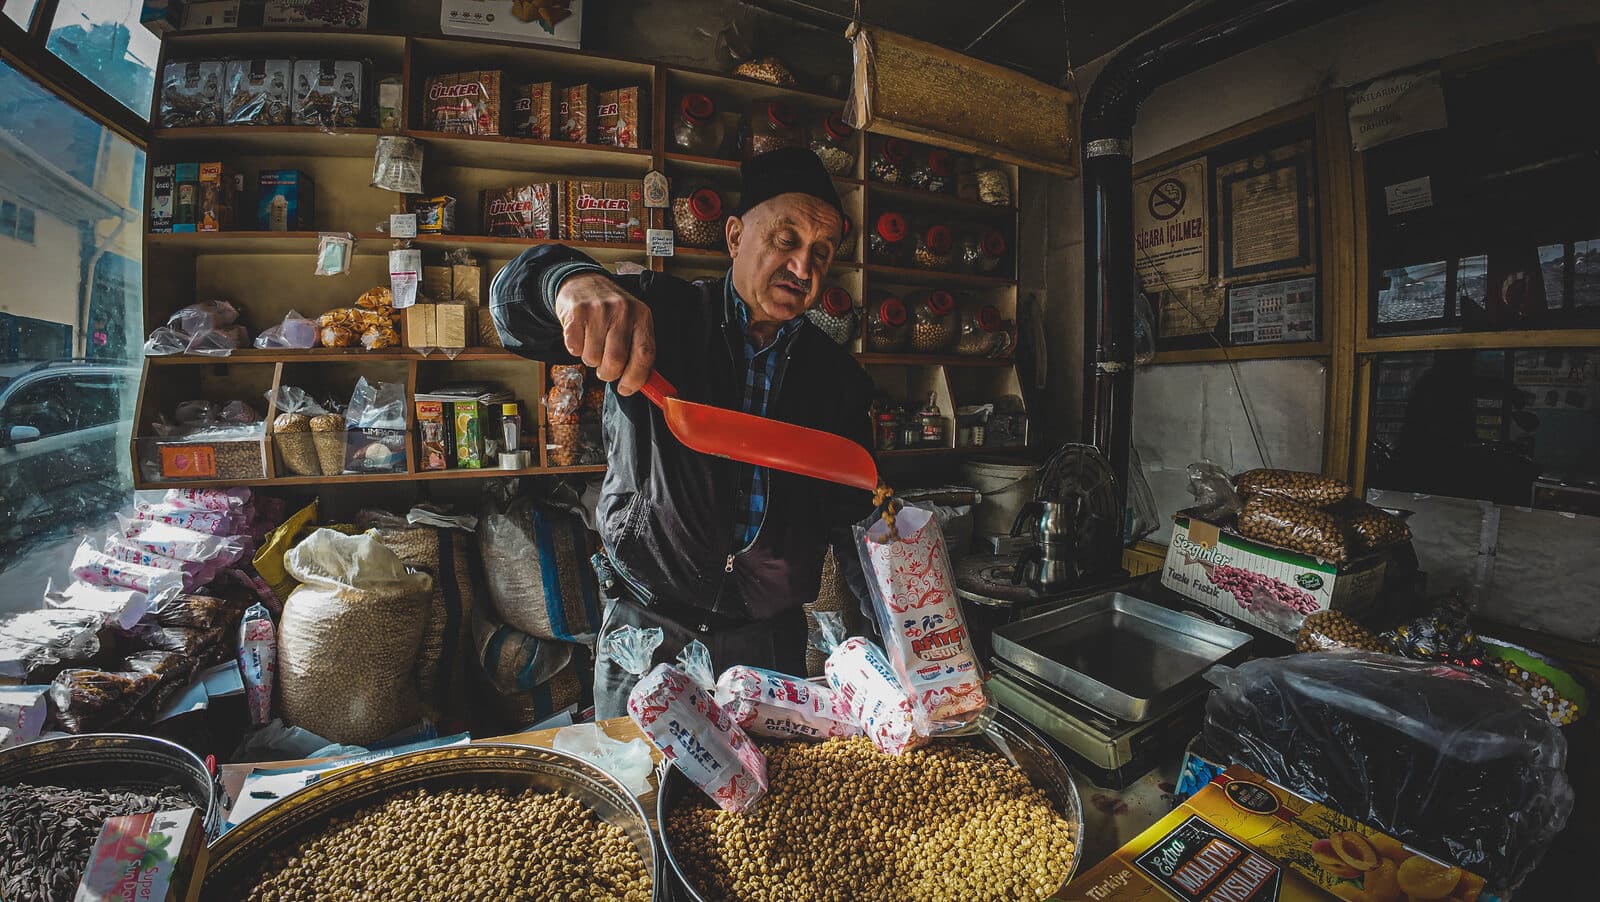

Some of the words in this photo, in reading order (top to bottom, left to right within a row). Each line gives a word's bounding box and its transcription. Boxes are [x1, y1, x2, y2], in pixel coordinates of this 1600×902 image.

[430, 81, 480, 100] ÜLKER
[490, 198, 533, 216] ÜLKER
[576, 194, 631, 211] ÜLKER
[1136, 228, 1165, 251] SİGARA
[1166, 217, 1203, 247] İÇİLMEZ
[1173, 533, 1230, 567] Sezginler
[1168, 566, 1190, 585] Tuzlu
[911, 624, 967, 654] AFİYET
[764, 718, 819, 736] AFİYET
[669, 719, 722, 771] AFİYET
[123, 860, 141, 882] Sun
[1151, 839, 1186, 877] Extra
[1176, 840, 1238, 893] MALATYA
[138, 866, 158, 900] Super
[1086, 868, 1133, 901] Türkiye
[1206, 855, 1272, 902] AYISILARI
